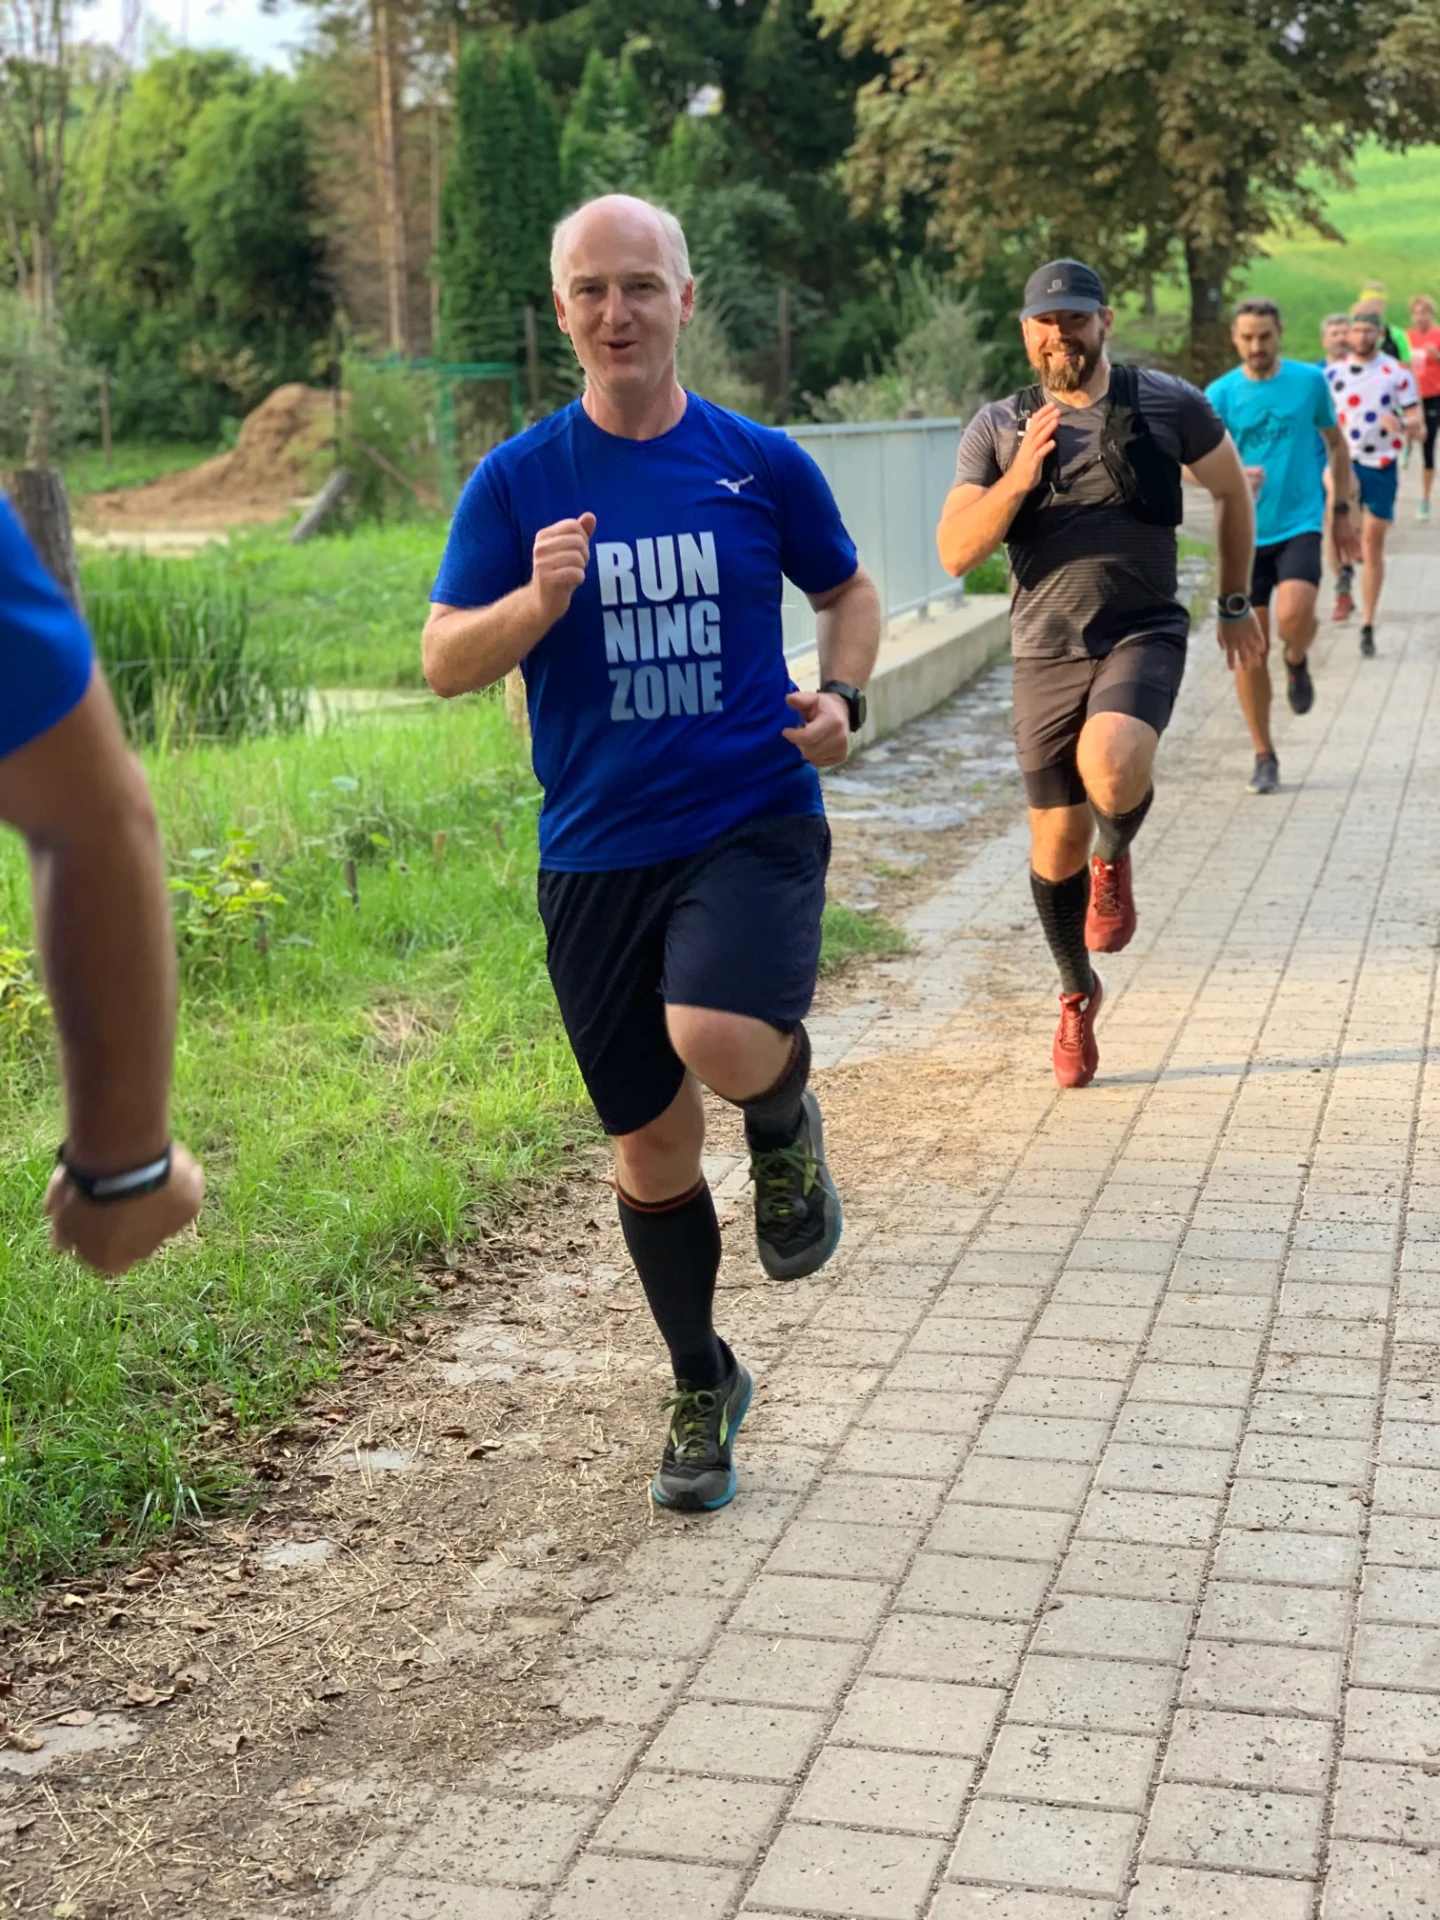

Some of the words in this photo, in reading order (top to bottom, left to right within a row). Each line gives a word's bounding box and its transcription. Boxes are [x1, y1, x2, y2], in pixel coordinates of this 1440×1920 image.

[595, 531, 720, 606] RUN
[603, 600, 722, 664] NING
[608, 661, 723, 721] ZONE
